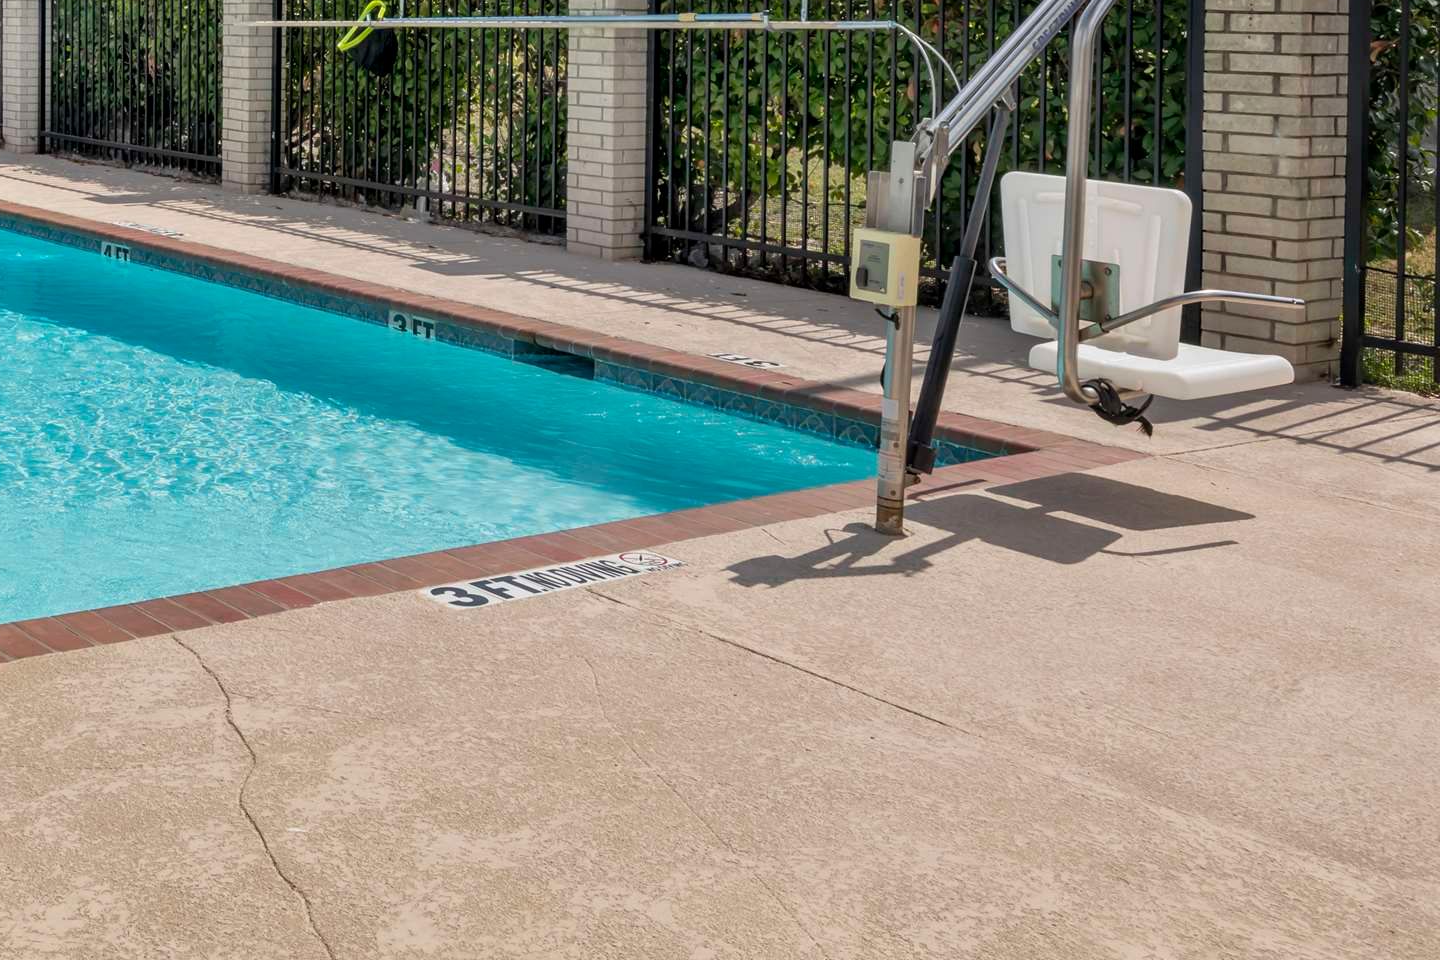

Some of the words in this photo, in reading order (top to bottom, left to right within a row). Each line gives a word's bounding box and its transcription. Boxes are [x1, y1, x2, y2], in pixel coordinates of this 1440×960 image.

[393, 314, 408, 332] 3
[412, 319, 435, 339] FT
[518, 570, 570, 592] NO
[542, 559, 641, 585] DIVING
[430, 586, 489, 607] 3
[468, 575, 542, 600] FT
